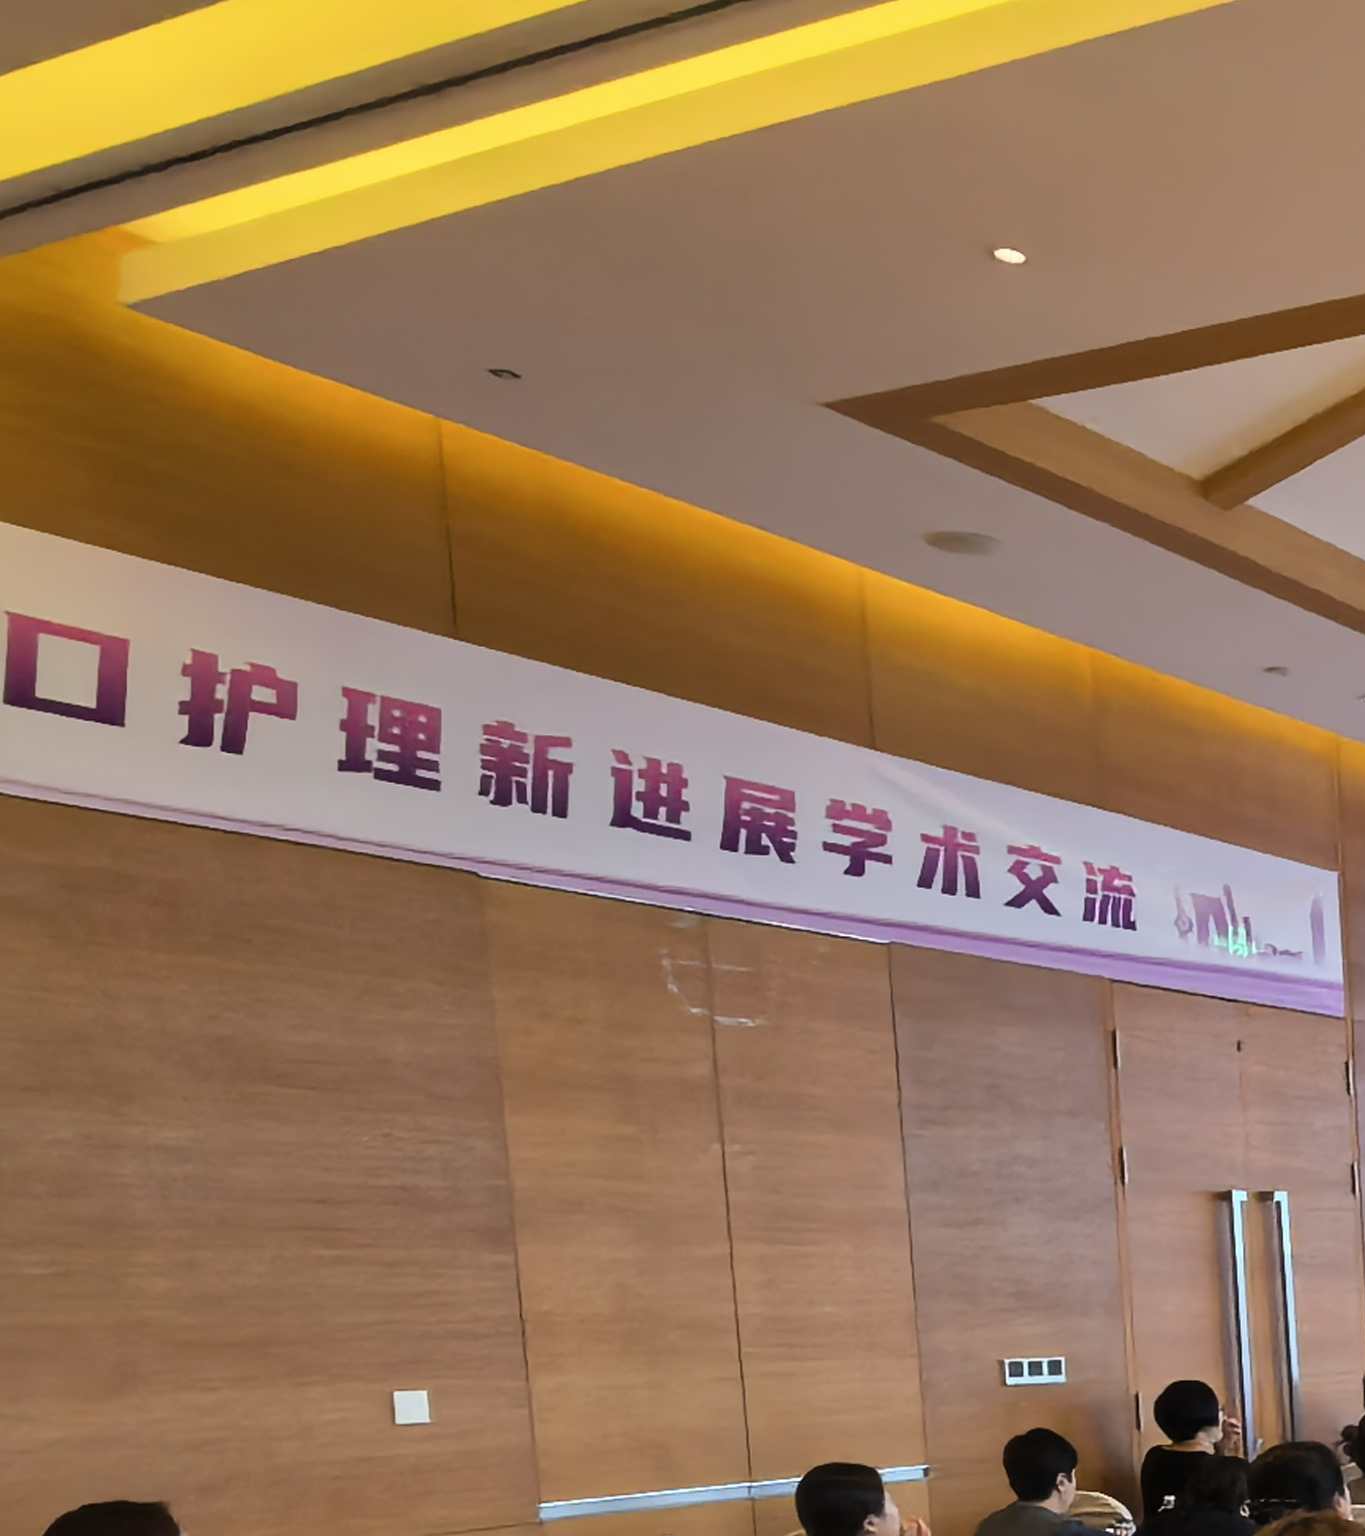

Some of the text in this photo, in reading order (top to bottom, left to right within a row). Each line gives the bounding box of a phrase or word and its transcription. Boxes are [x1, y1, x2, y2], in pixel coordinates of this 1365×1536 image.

[3, 609, 1141, 933] 口护理新进展学术交流
